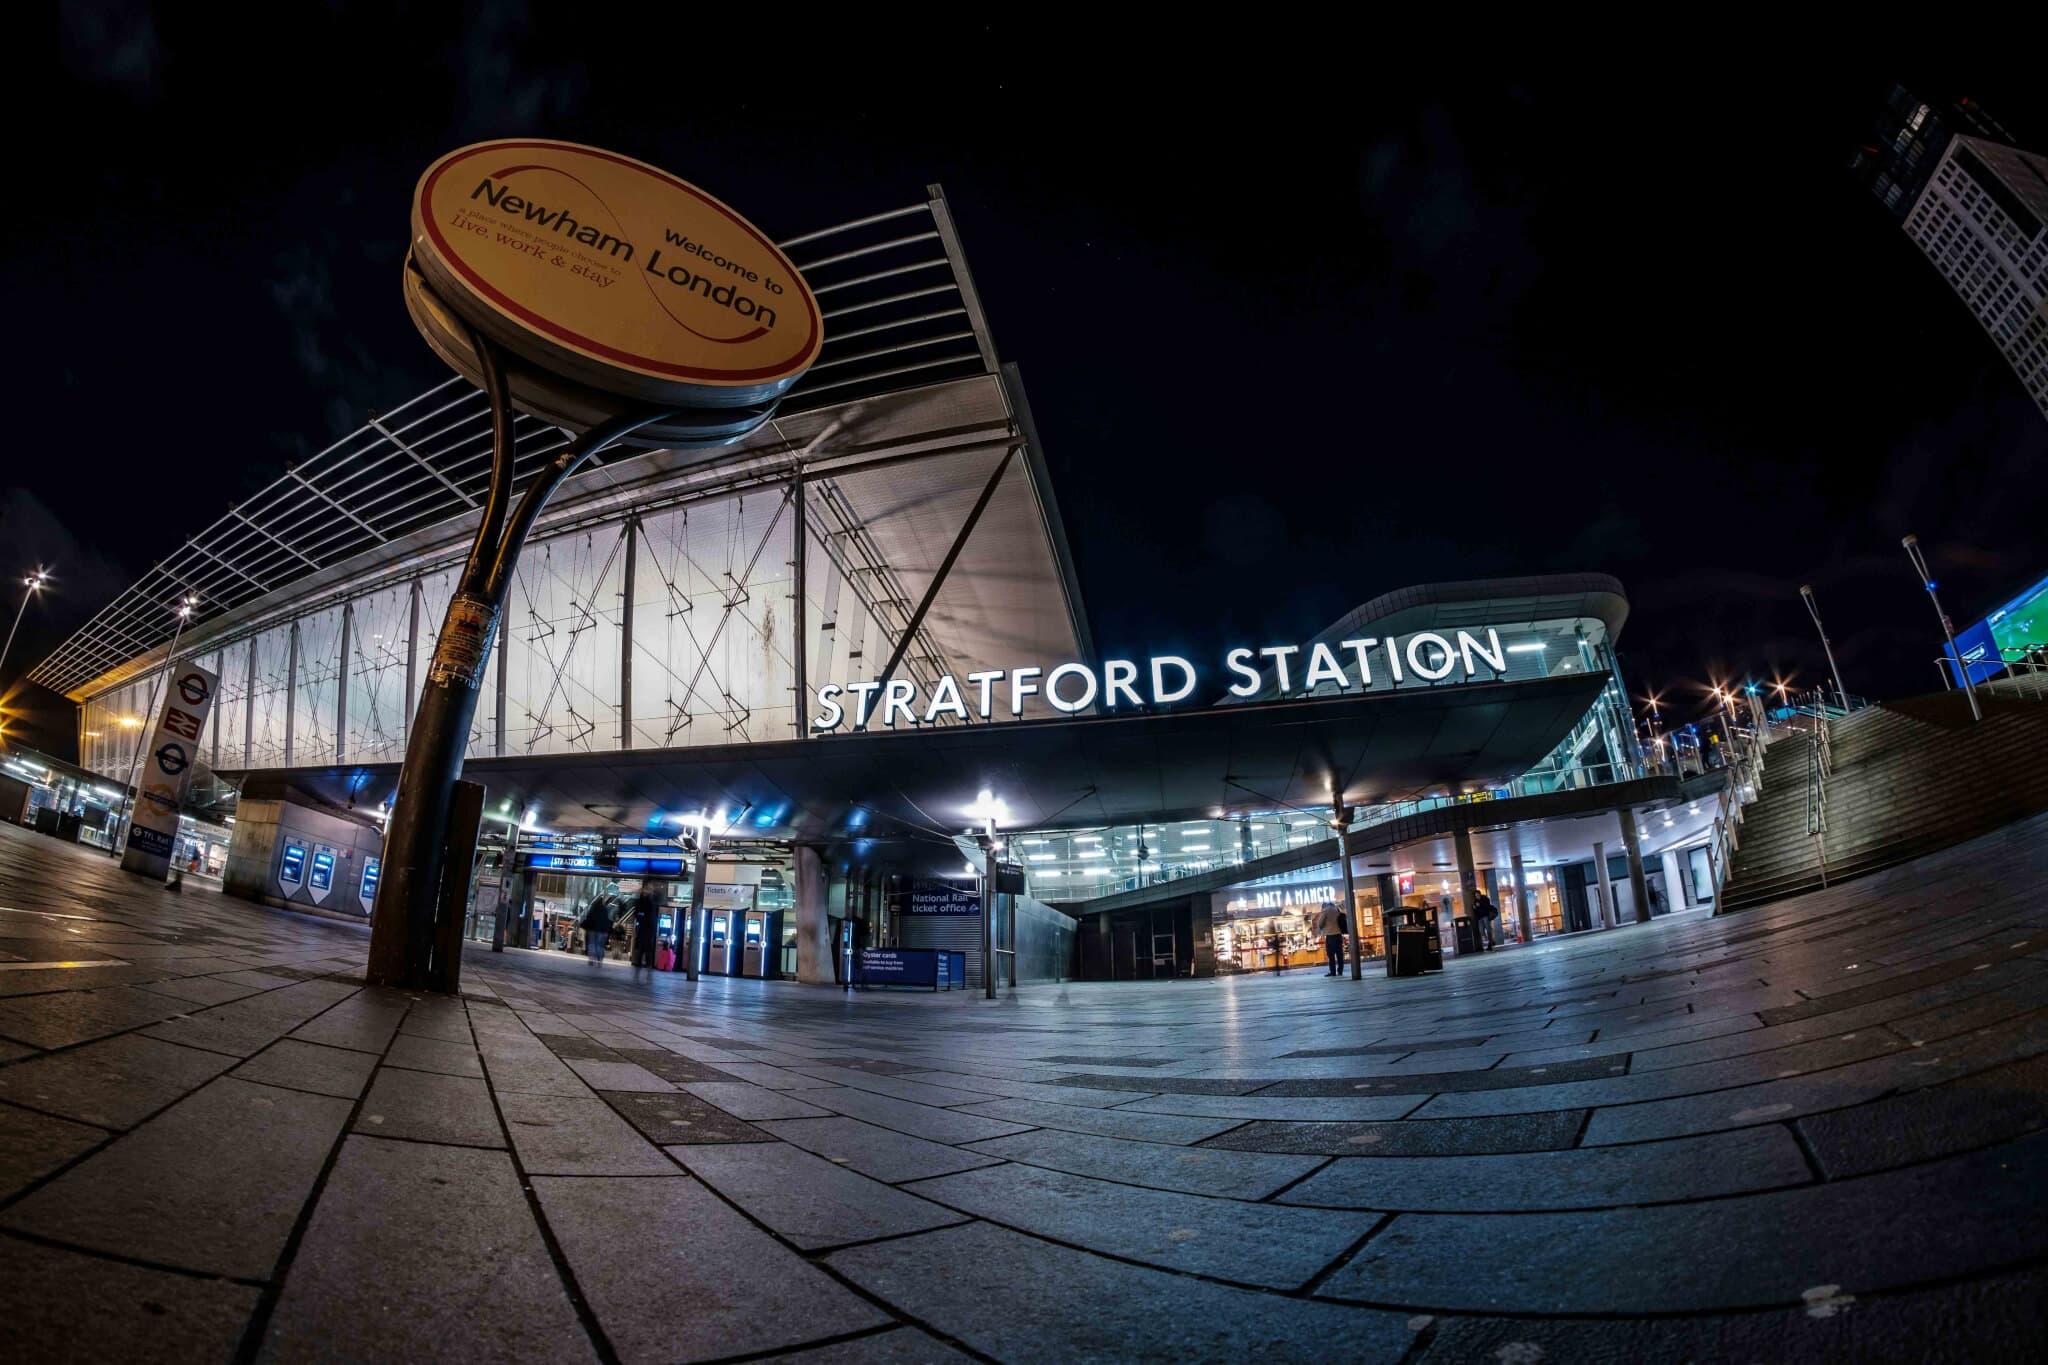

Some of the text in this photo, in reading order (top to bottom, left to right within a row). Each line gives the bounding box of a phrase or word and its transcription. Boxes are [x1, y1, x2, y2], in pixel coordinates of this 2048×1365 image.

[467, 210, 497, 226] place
[500, 221, 532, 240] where
[533, 235, 570, 256] people
[570, 250, 608, 271] choose
[470, 178, 777, 329] Newham London
[495, 231, 546, 260] work
[550, 255, 566, 268] &
[570, 262, 615, 288] stay
[665, 227, 784, 296] Welcome to
[814, 627, 1508, 730] STRATFORD STATION
[553, 857, 587, 867] STRATFORD
[706, 886, 727, 895] Tickets
[912, 893, 968, 903] National Rail
[1256, 886, 1336, 908] PRET A MANGER
[912, 903, 967, 913] ticket office
[863, 952, 881, 960] Oyster
